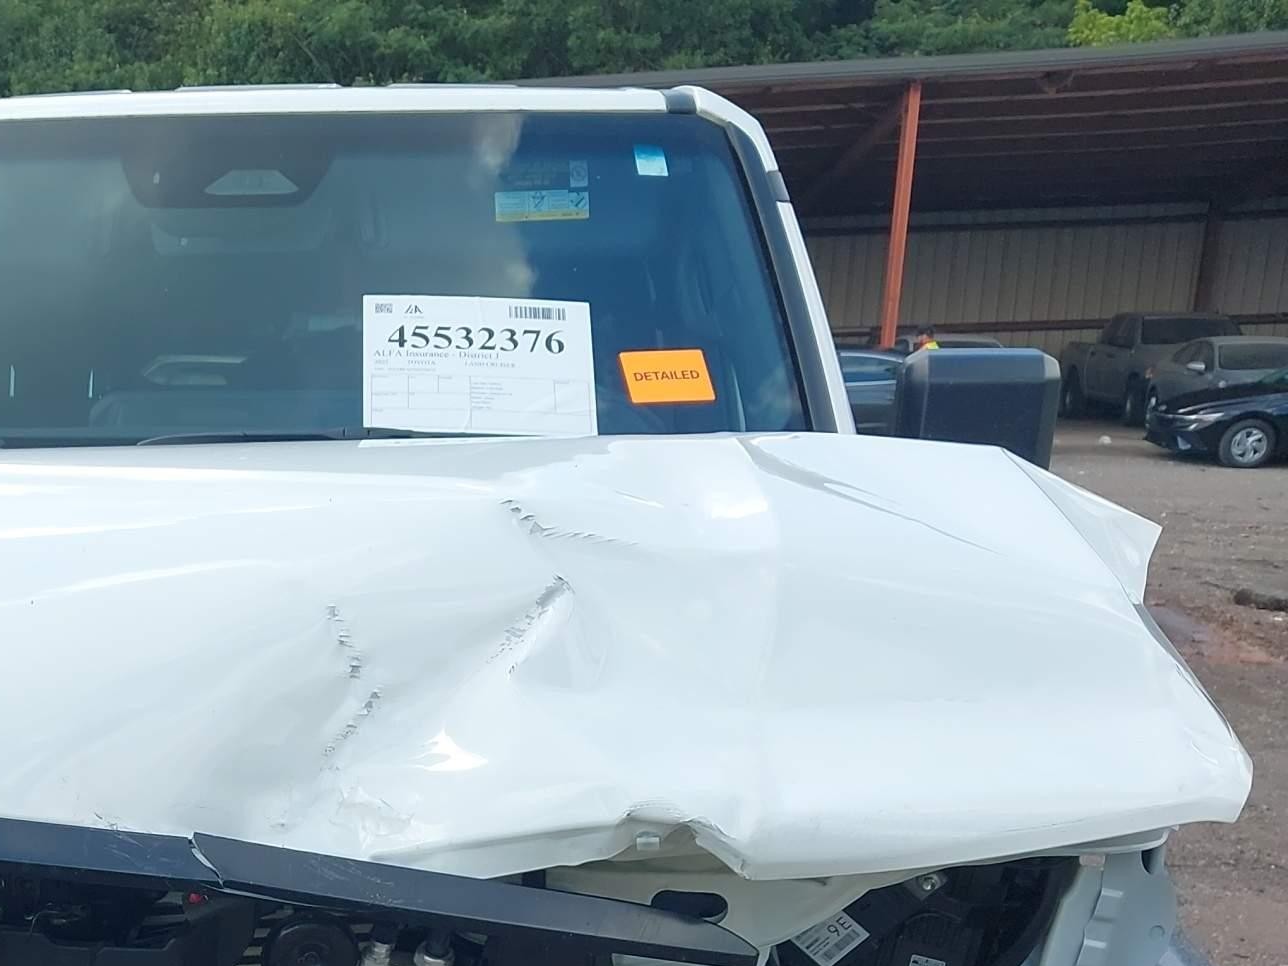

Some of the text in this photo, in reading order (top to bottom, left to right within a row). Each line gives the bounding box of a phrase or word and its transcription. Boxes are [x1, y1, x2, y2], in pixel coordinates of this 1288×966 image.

[387, 324, 565, 354] 45532376
[406, 350, 449, 358] Insurance
[458, 351, 492, 360] District
[633, 369, 700, 382] DETAILED
